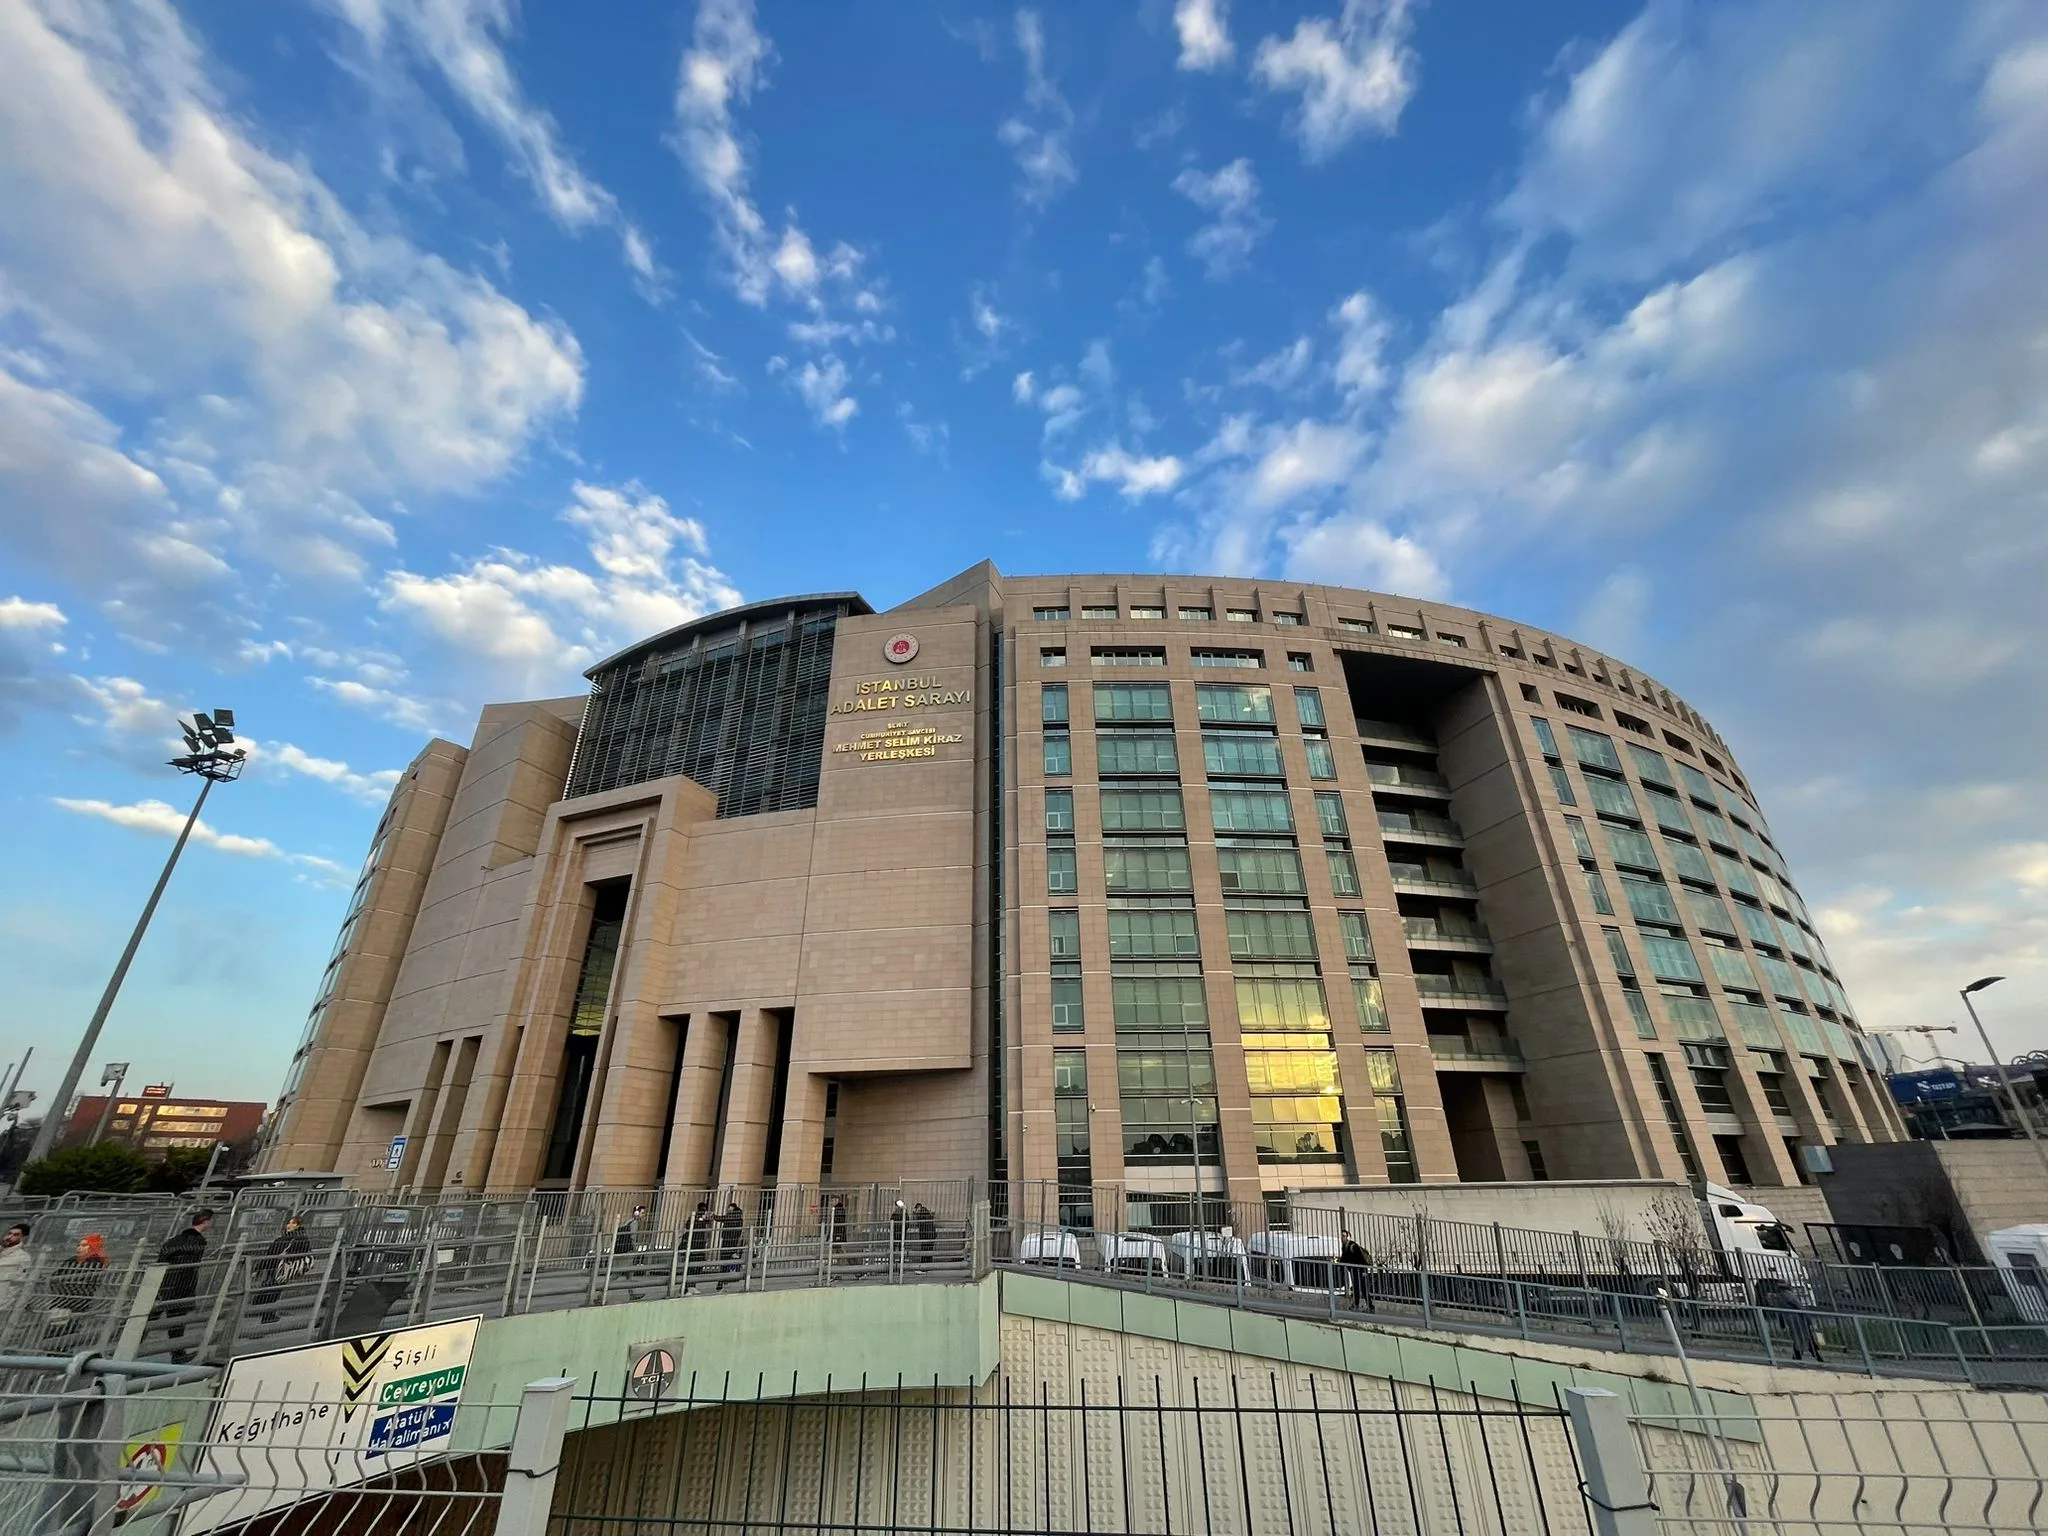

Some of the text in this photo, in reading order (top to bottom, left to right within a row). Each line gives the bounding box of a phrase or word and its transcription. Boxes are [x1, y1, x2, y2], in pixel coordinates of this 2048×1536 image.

[856, 676, 942, 695] İSTANBUL
[830, 690, 970, 715] ADALET SARAYI
[832, 734, 963, 753] MEHMET SELİM KİRAZ
[859, 745, 935, 762] YERLEŞKESİ
[393, 1345, 437, 1369] Şişli
[217, 1405, 329, 1443] Kağıthane
